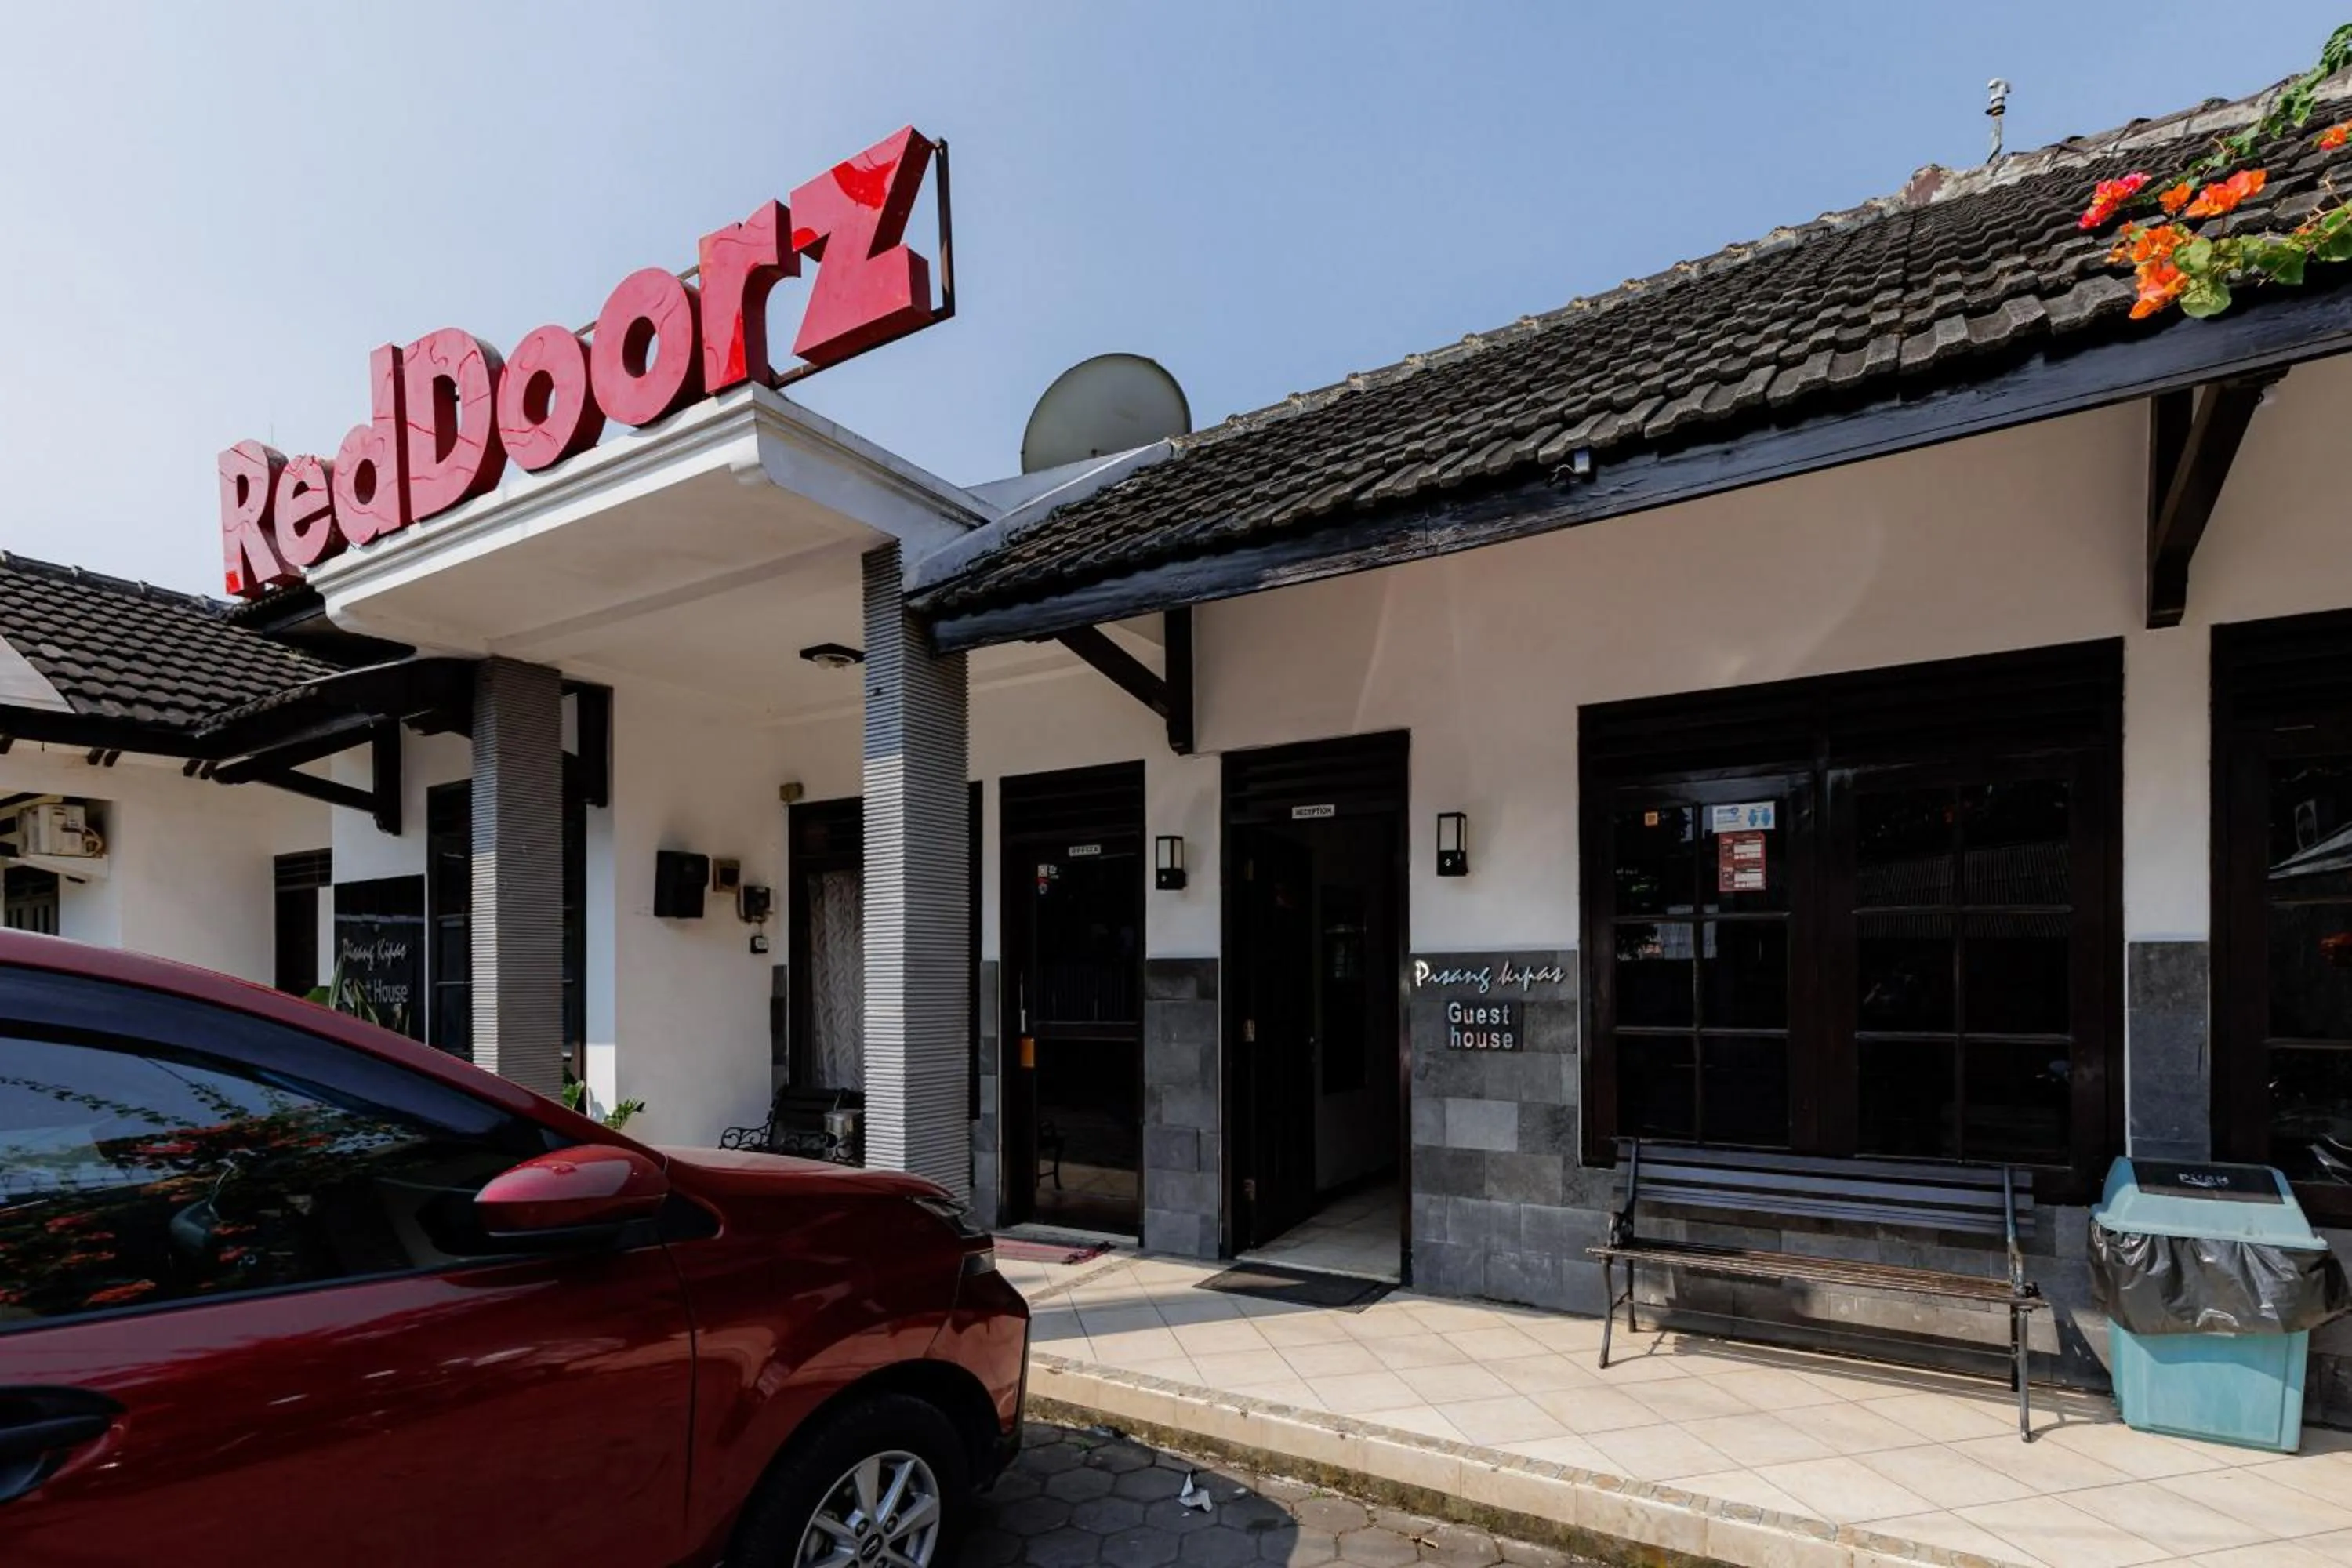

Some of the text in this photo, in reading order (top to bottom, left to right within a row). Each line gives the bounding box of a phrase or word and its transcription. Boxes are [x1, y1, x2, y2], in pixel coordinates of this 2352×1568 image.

[217, 125, 933, 598] RedDoorz
[1414, 959, 1490, 993] Pisang
[374, 979, 408, 1004] House
[1448, 1001, 1511, 1025] Guest
[1450, 1025, 1514, 1048] house
